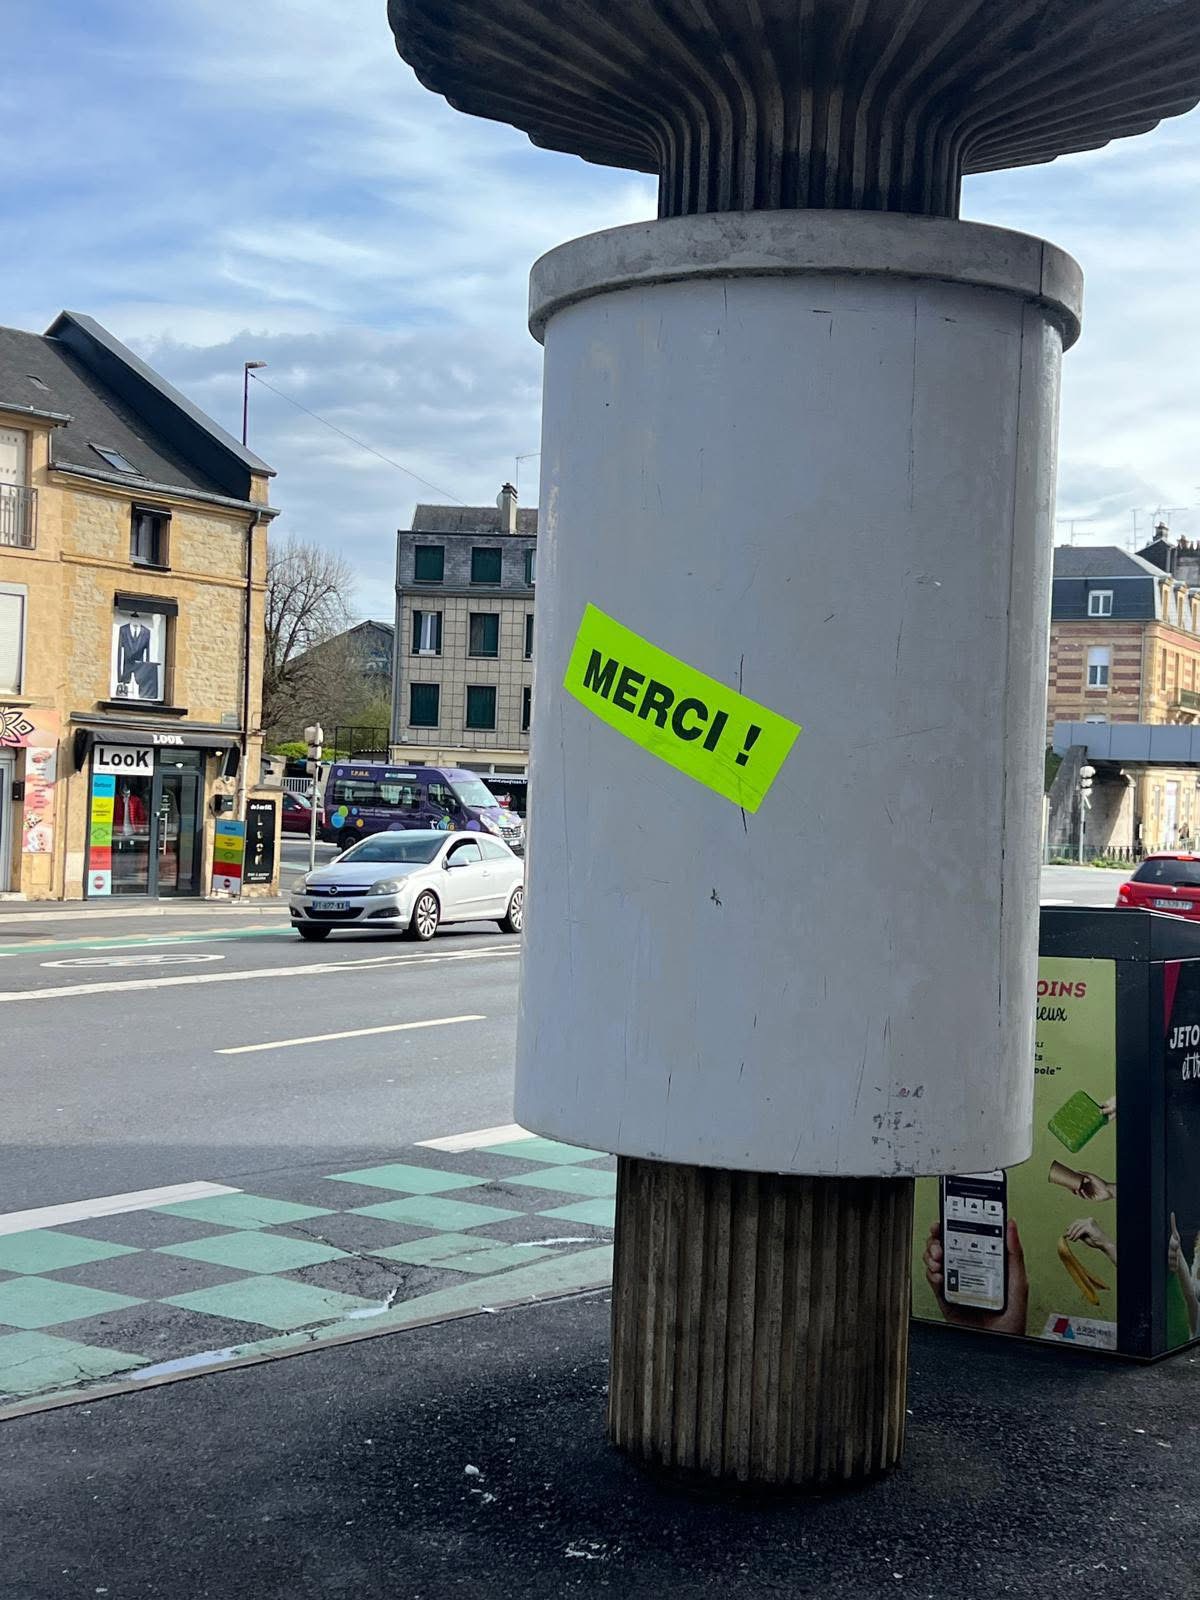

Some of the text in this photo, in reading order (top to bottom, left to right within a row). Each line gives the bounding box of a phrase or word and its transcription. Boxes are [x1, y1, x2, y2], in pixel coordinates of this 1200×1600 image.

[582, 648, 762, 767] MERCI !
[152, 734, 184, 745] LOOK
[99, 747, 150, 768] LooK
